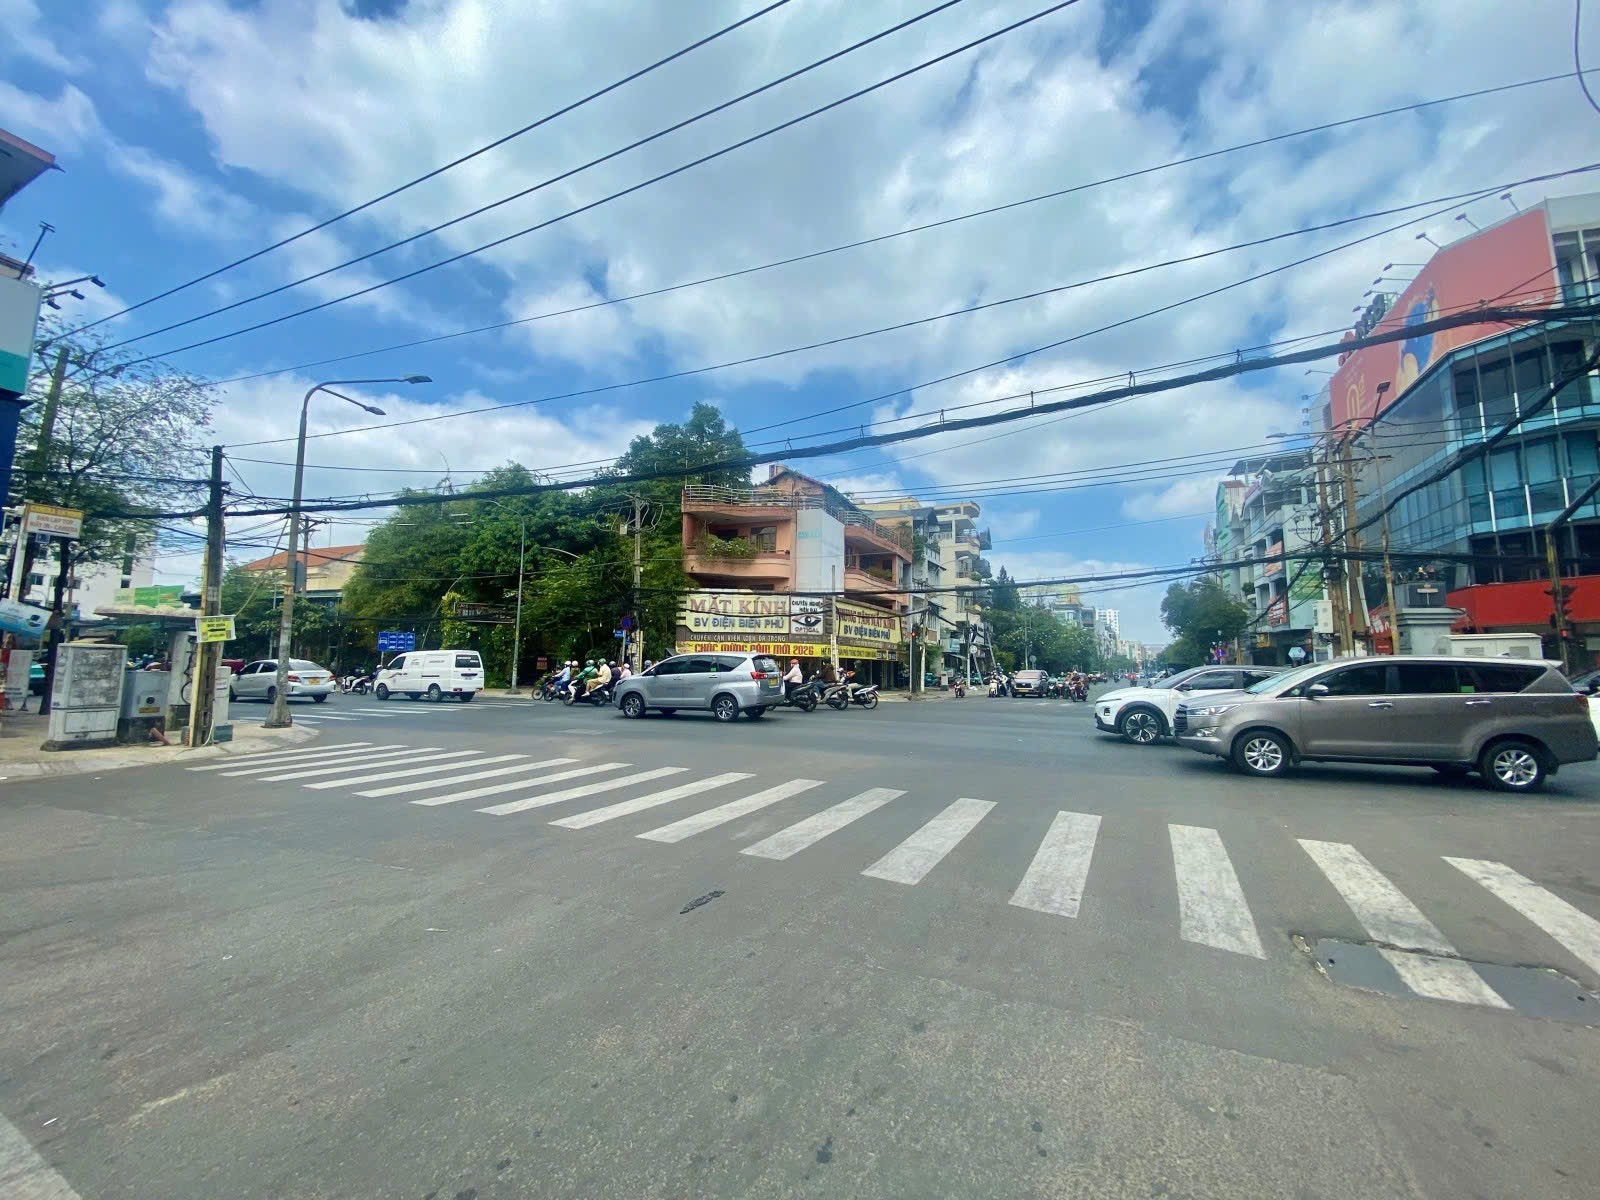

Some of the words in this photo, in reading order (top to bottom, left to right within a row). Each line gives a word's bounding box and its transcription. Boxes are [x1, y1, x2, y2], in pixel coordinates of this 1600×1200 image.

[738, 597, 787, 615] KÍNH
[694, 617, 709, 627] BV
[712, 616, 735, 629] ĐIỆN
[764, 616, 785, 629] PHỦ
[843, 624, 853, 634] BV
[793, 645, 814, 655] 2026
